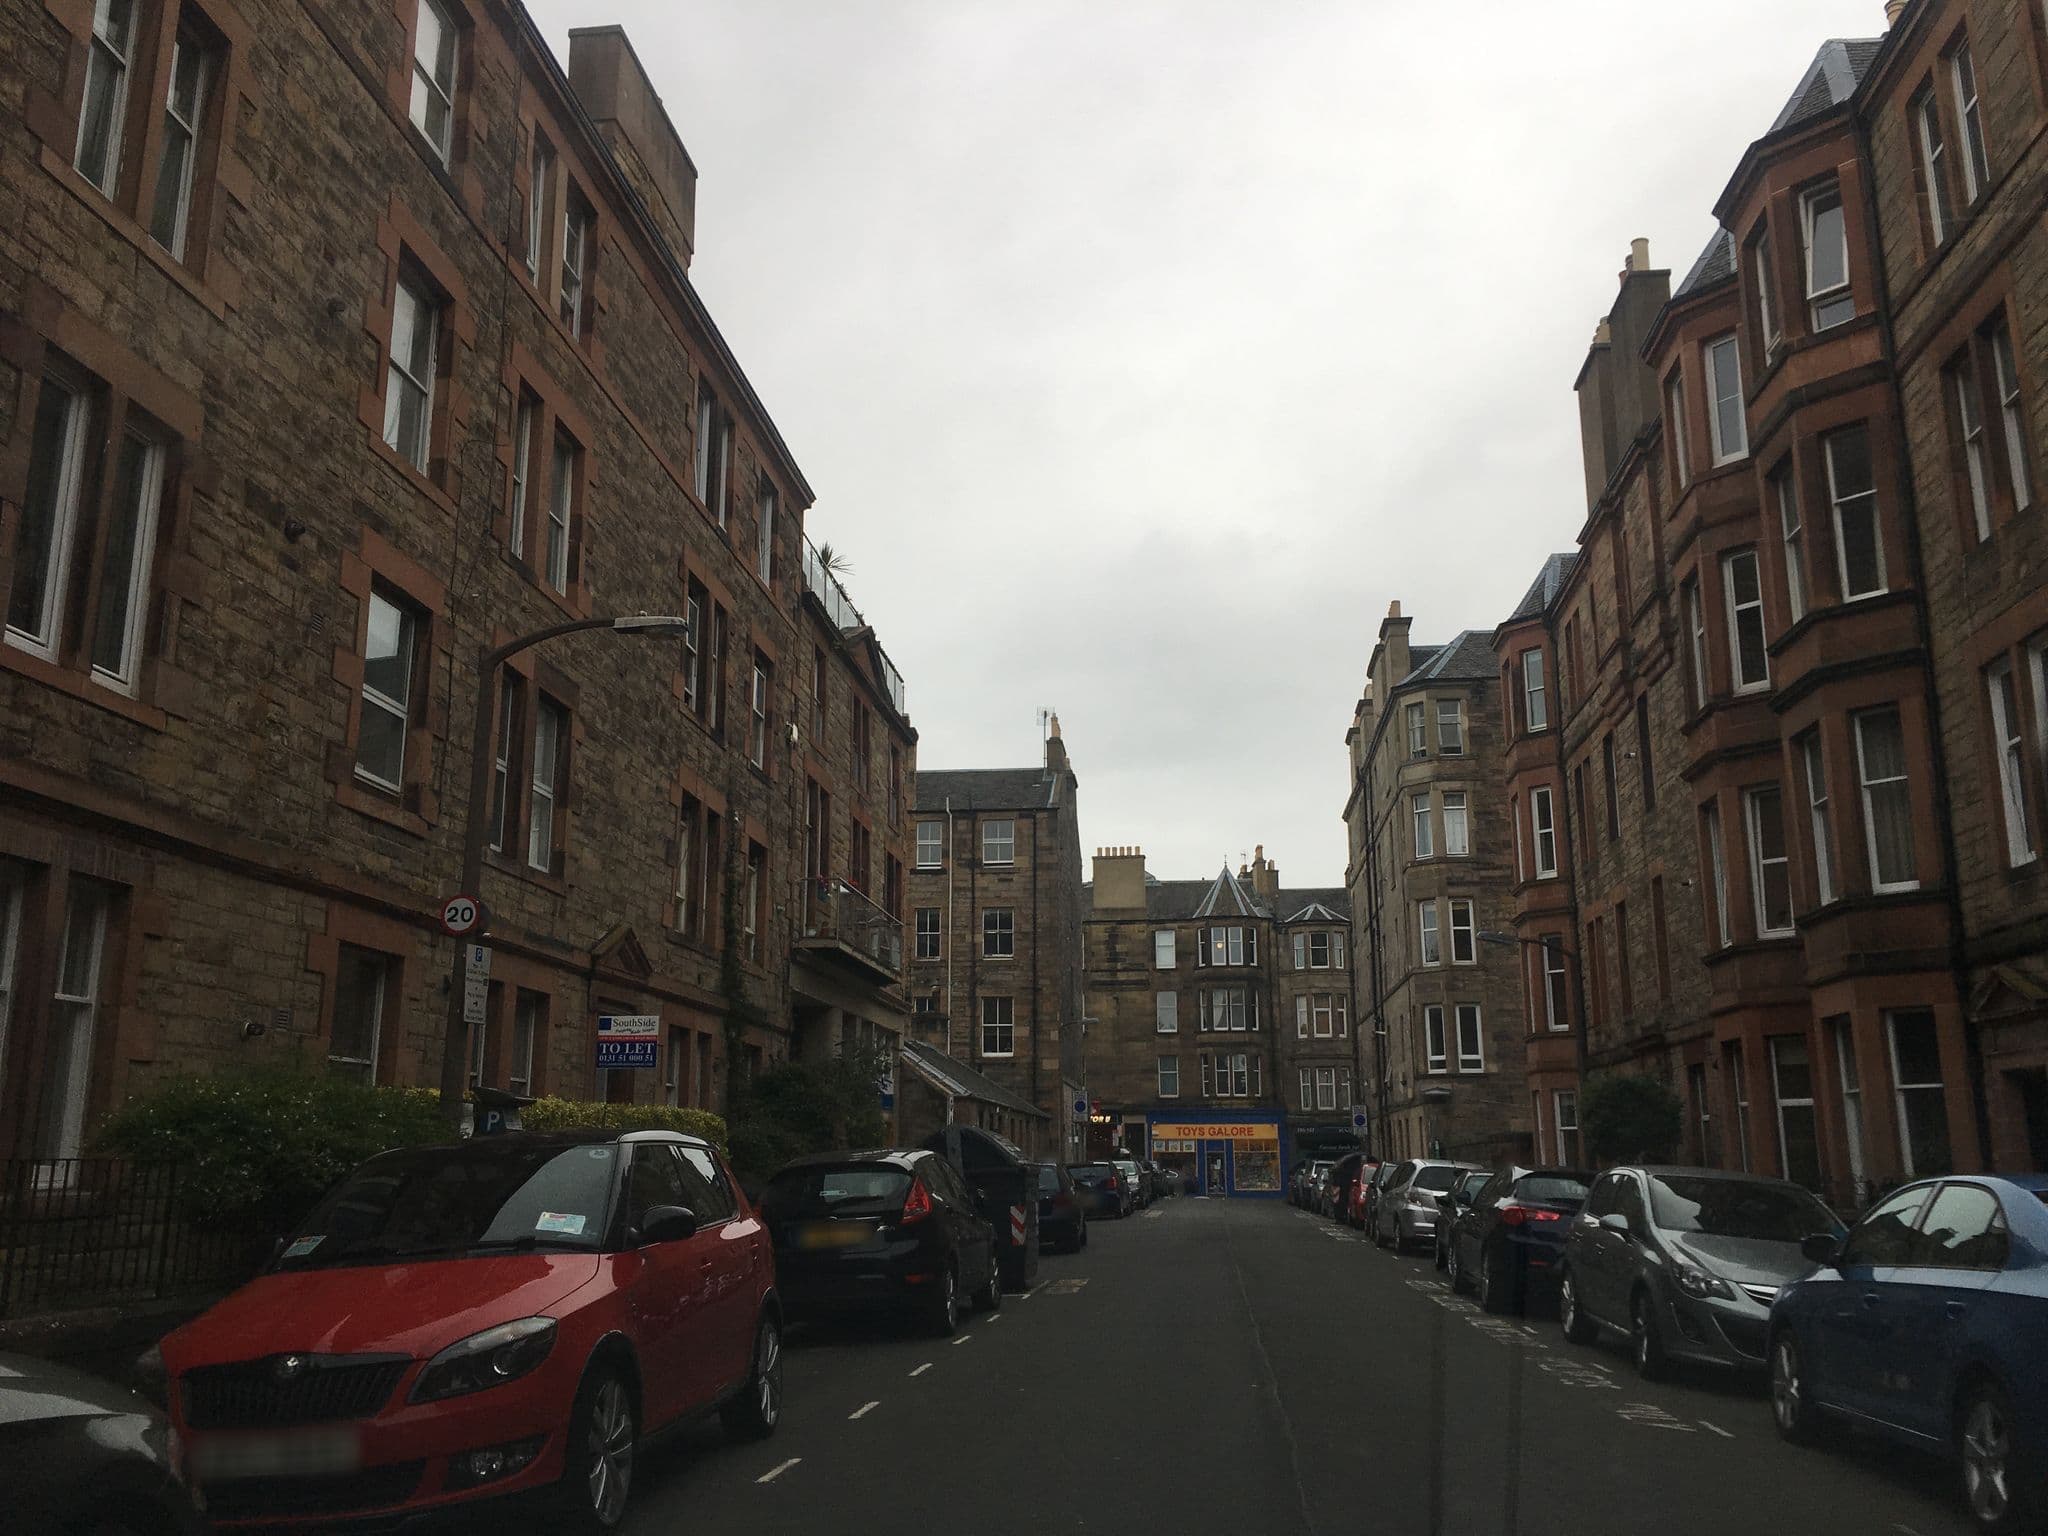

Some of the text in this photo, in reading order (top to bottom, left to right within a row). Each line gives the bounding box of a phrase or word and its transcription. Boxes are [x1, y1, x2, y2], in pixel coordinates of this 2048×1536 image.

[447, 906, 473, 922] 20
[613, 1017, 656, 1027] SouthSide
[599, 1042, 655, 1054] TO LET
[599, 1054, 616, 1062] 0131
[487, 1111, 500, 1131] P
[1175, 1126, 1254, 1137] TOYS GALORE
